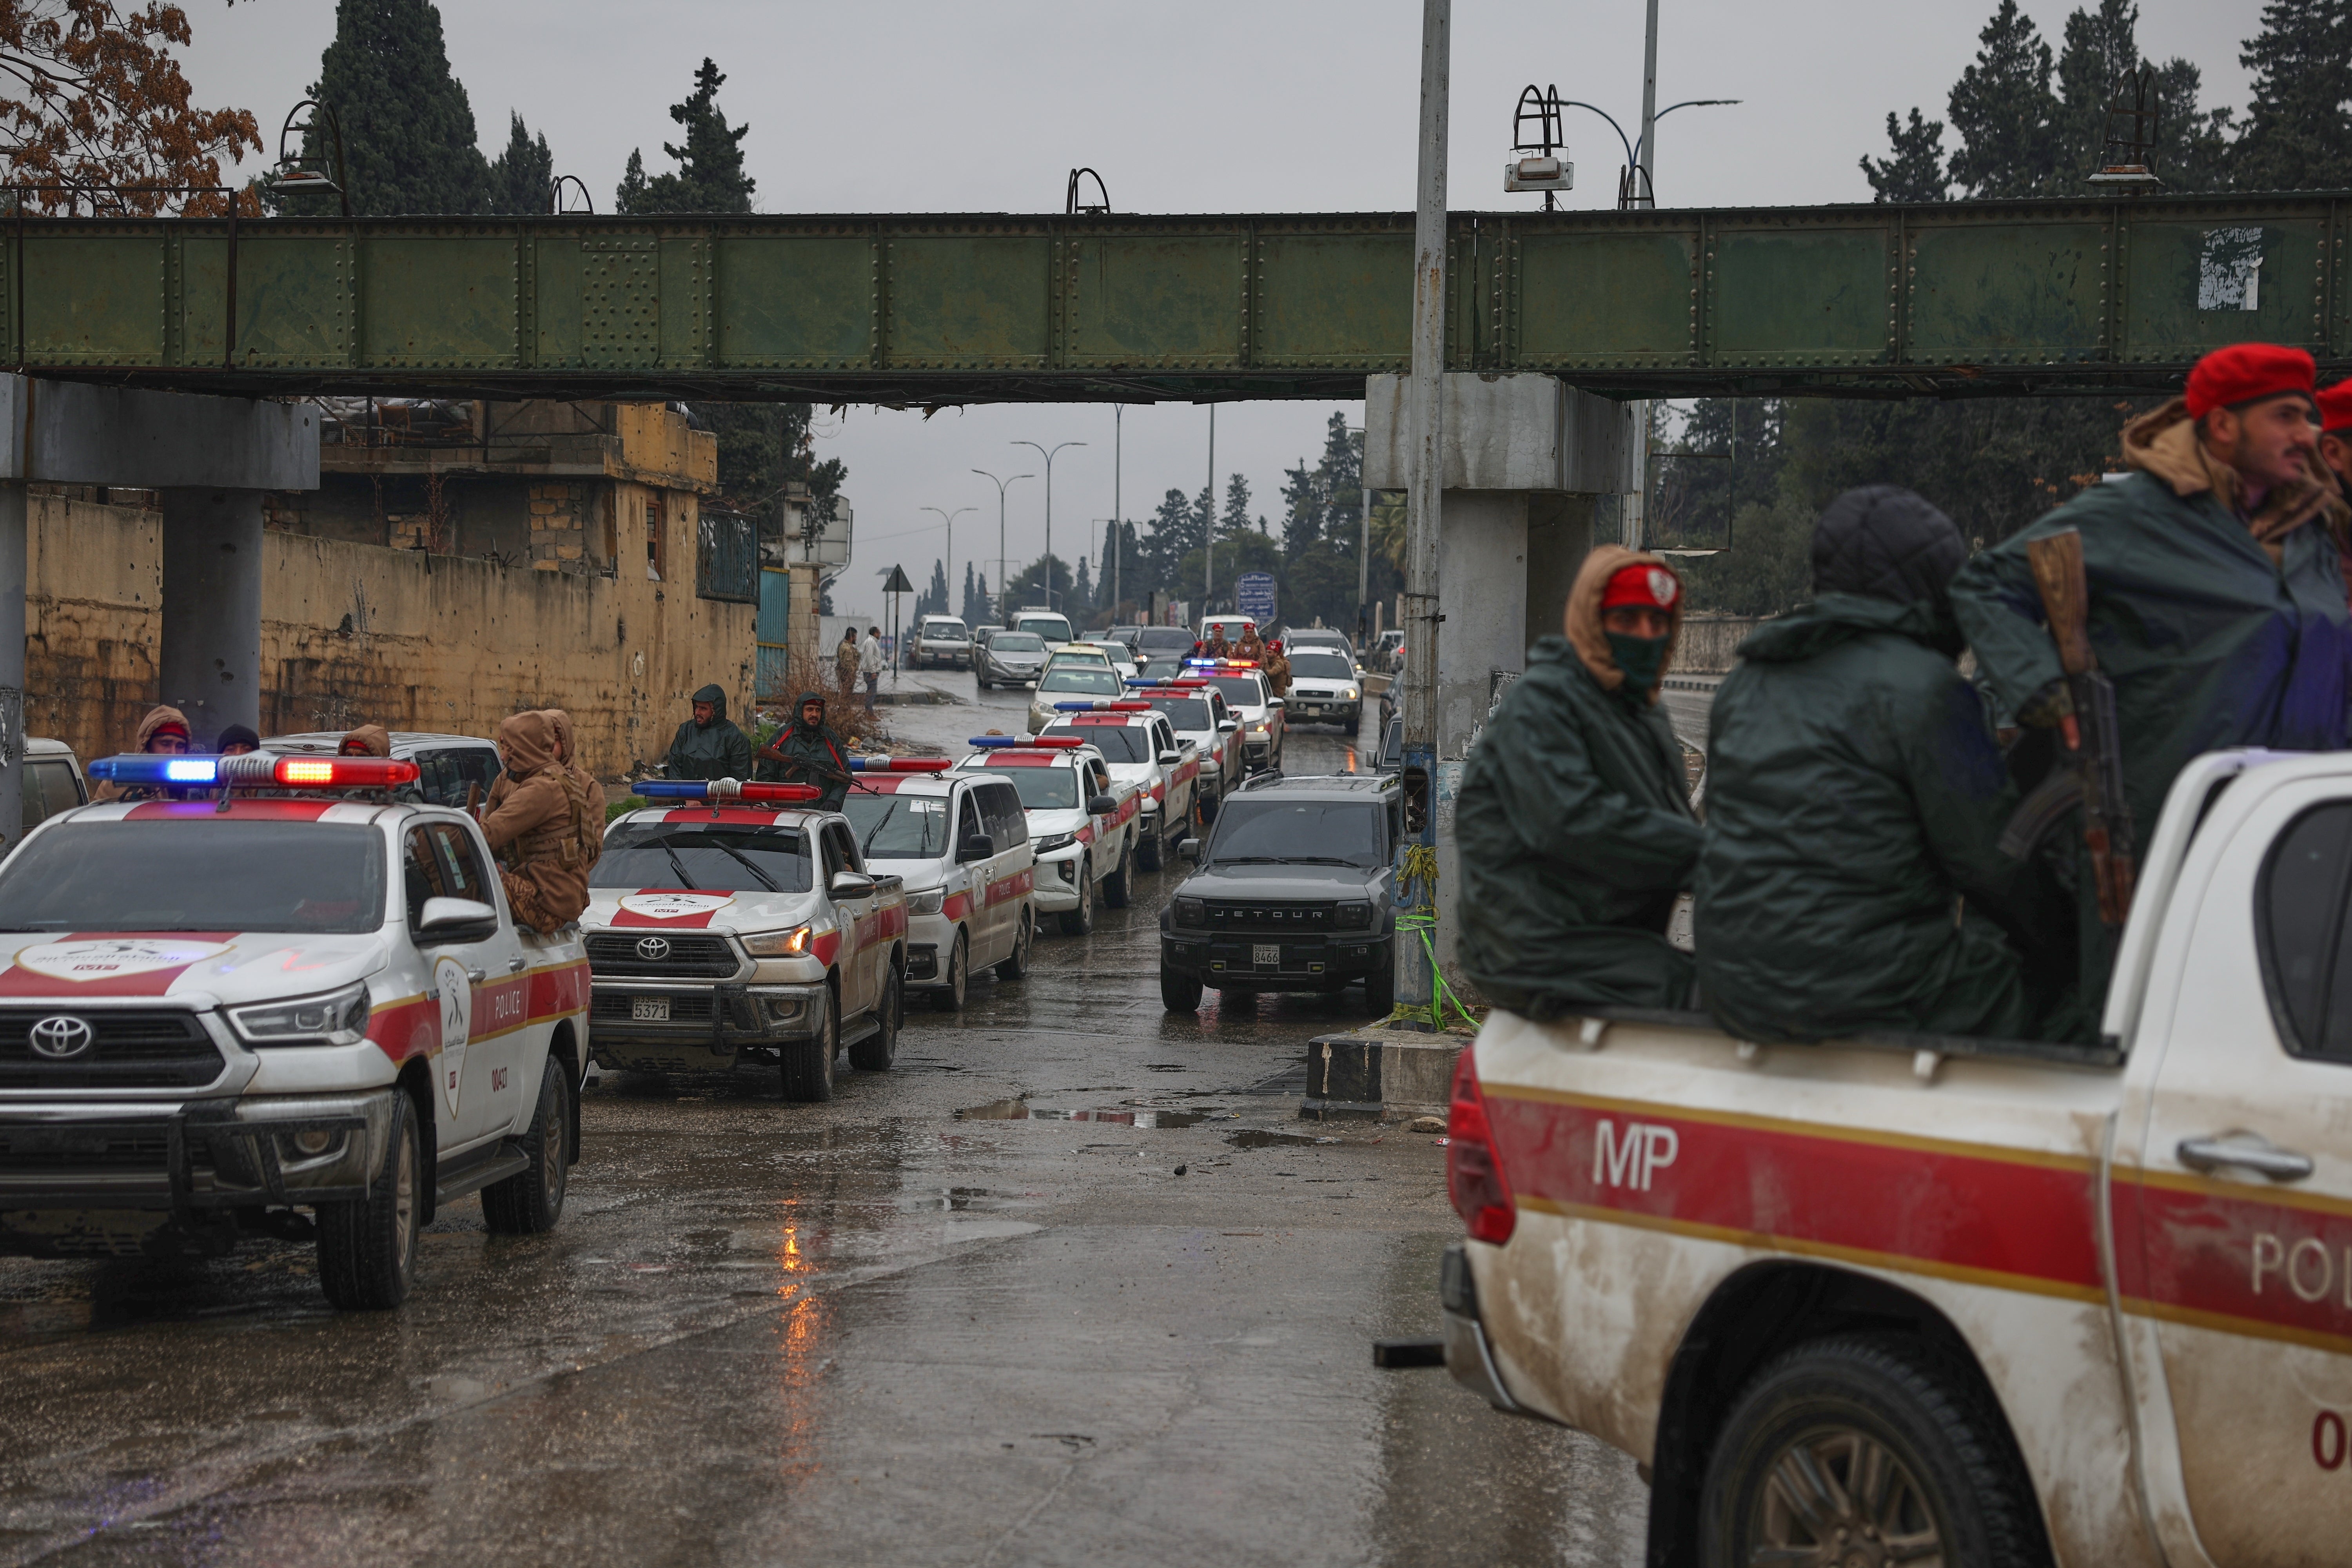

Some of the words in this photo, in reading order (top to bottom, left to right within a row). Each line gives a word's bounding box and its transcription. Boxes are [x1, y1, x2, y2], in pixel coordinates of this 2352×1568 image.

[999, 882, 1010, 896] POLICE
[1255, 953, 1278, 962] 8466
[495, 991, 520, 1019] POLICE
[635, 1004, 667, 1018] 5371
[1593, 1119, 1679, 1192] MP
[2311, 1409, 2352, 1472] 0
